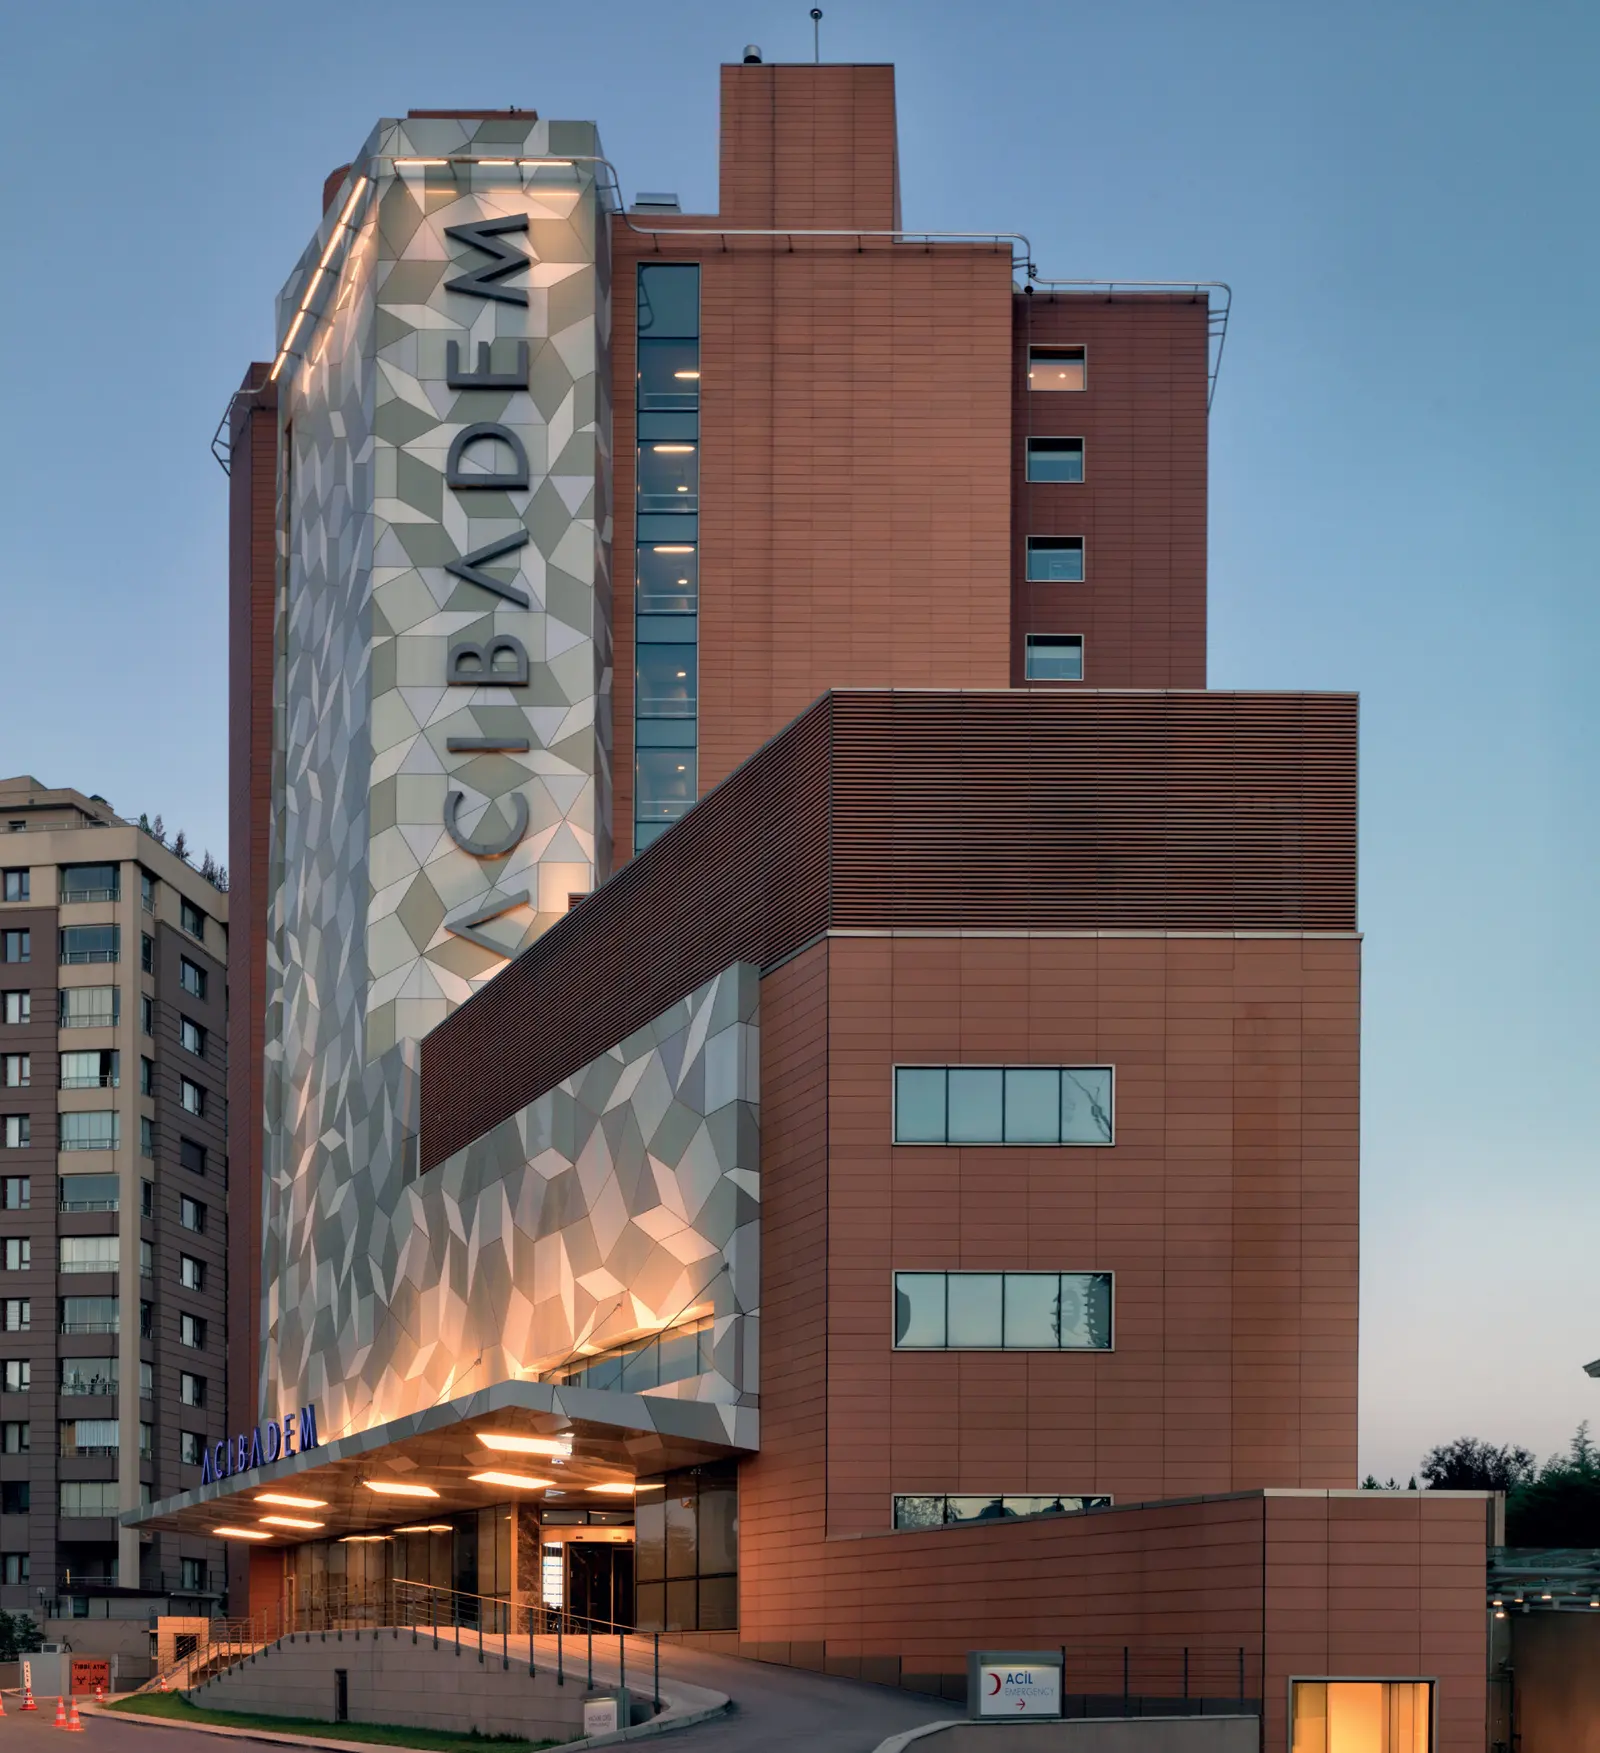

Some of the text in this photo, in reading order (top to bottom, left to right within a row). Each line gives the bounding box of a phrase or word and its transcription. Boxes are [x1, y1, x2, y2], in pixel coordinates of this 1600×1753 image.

[444, 212, 530, 960] ACIBADEM
[201, 1404, 318, 1485] ACIBADEM
[1004, 1687, 1054, 1697] EMERGENCY
[1005, 1670, 1033, 1684] ACİL
